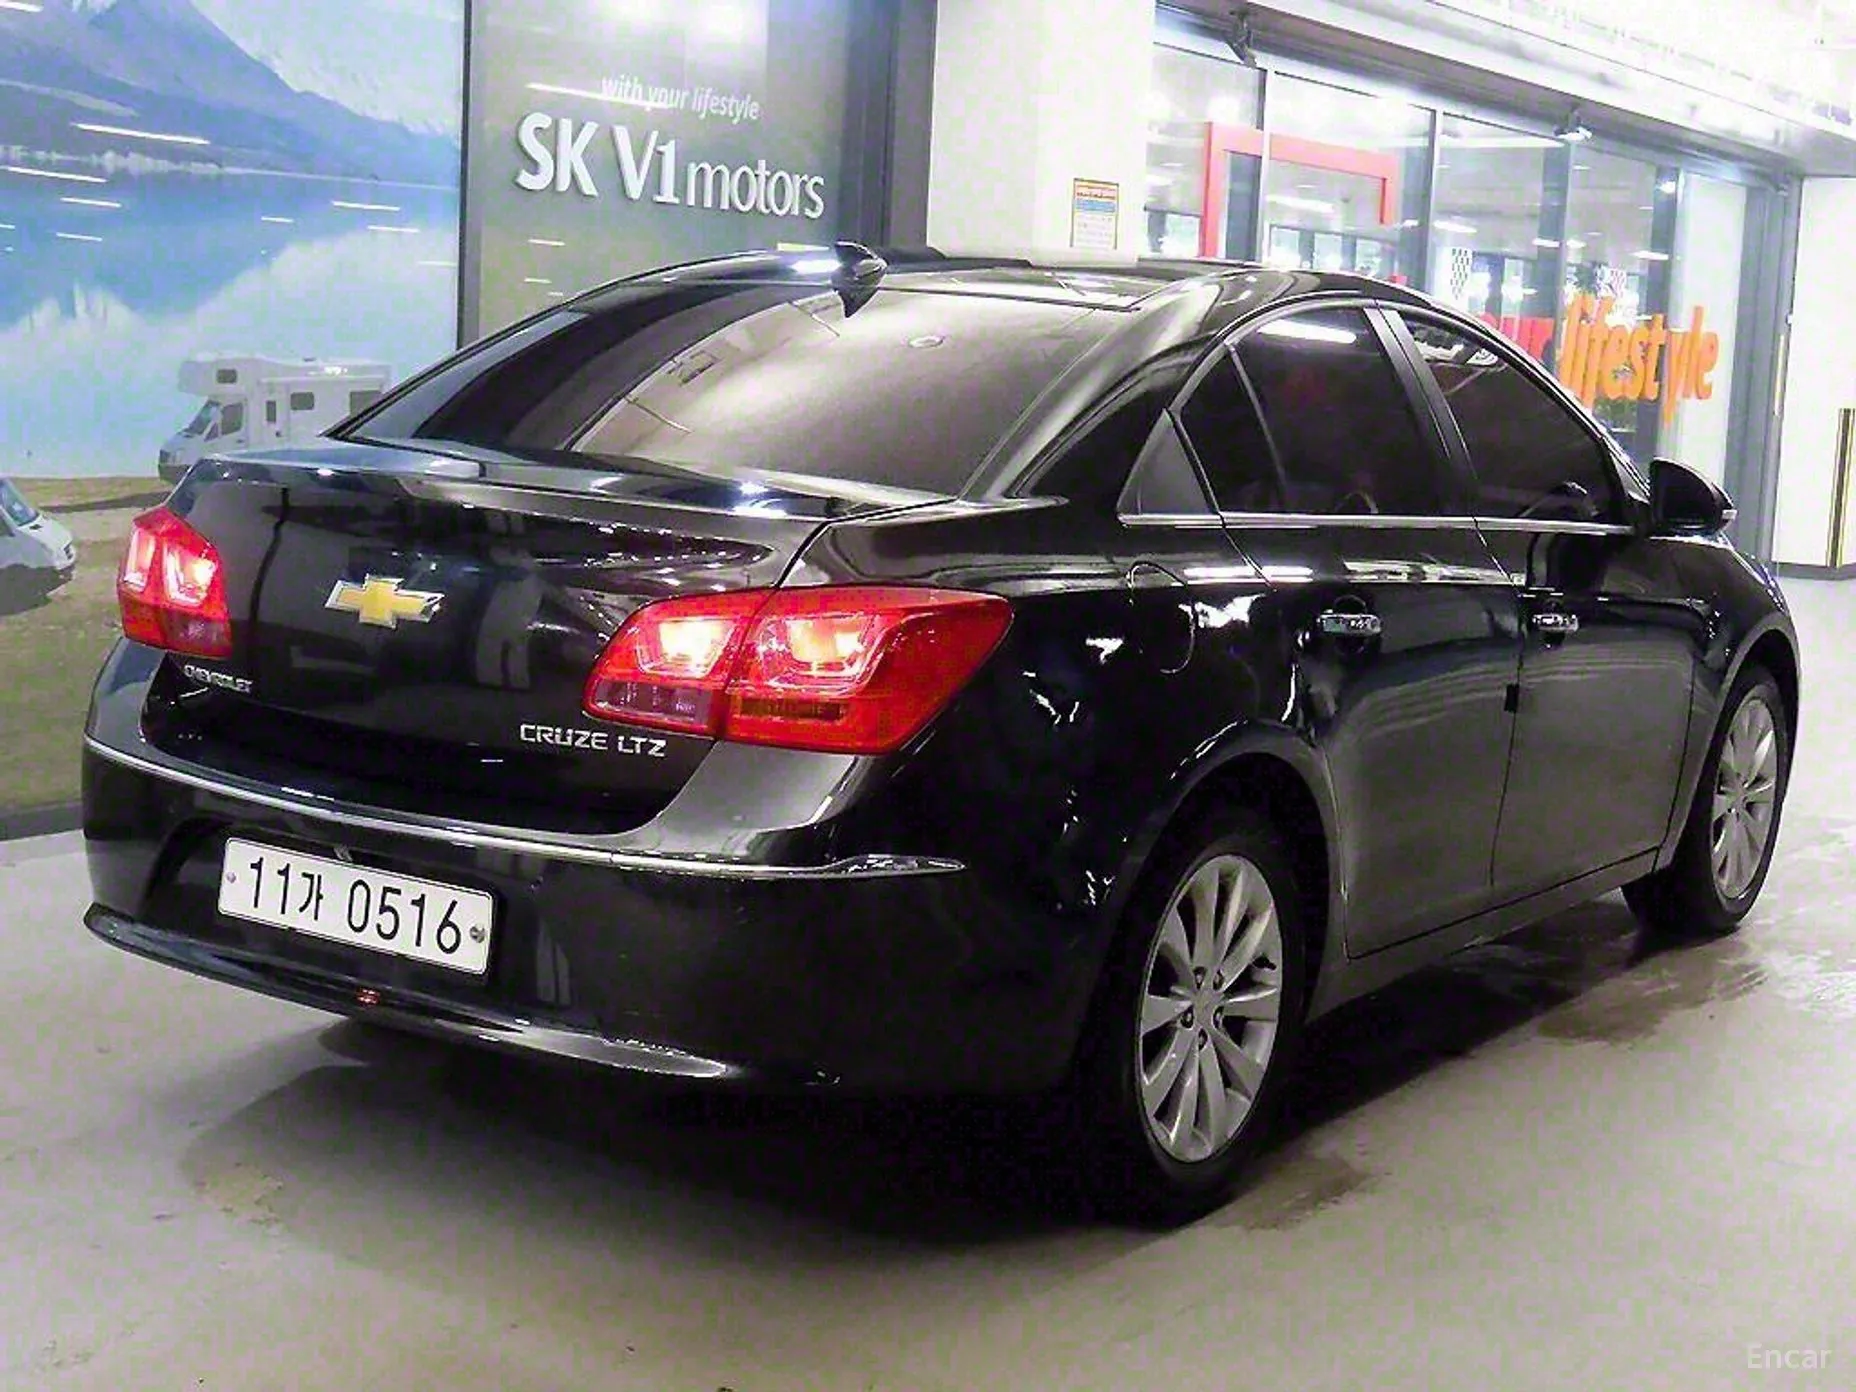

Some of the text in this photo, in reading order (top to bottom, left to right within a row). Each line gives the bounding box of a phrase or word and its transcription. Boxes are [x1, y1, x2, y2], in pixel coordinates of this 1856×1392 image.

[601, 74, 761, 125] with your lifestyle
[515, 111, 598, 198] SK
[1559, 293, 1719, 430] lifestyle
[519, 723, 667, 758] CRUZE LTZ
[249, 856, 462, 955] 11가 0516
